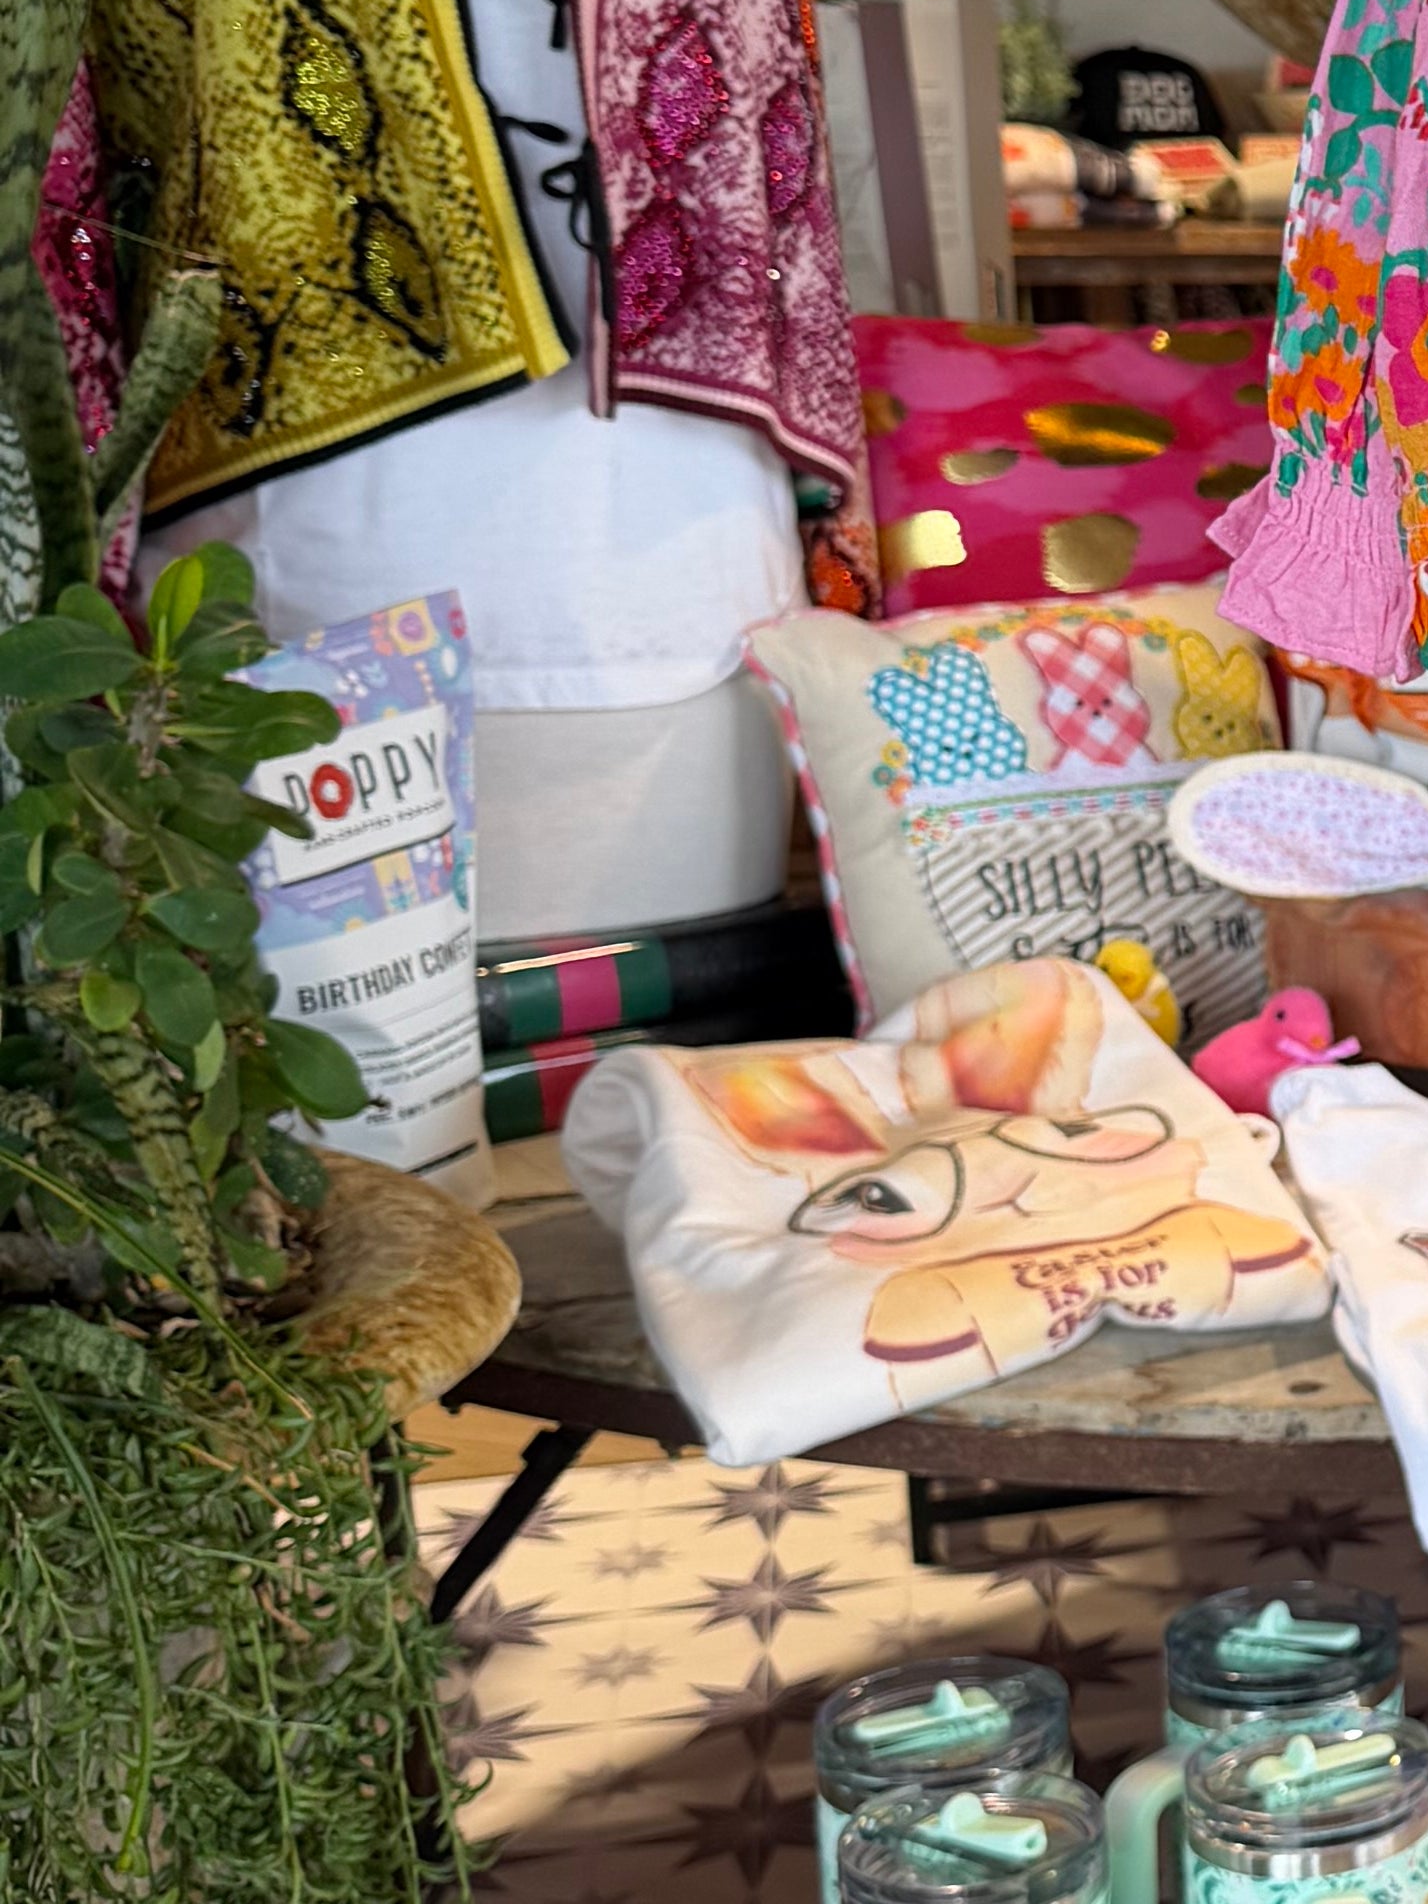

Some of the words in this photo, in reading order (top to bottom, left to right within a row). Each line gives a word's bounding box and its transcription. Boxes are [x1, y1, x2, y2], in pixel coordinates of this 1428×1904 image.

[283, 730, 441, 821] POPPY
[976, 846, 1105, 923] SILLY
[297, 952, 416, 1017] BIRTHDAY
